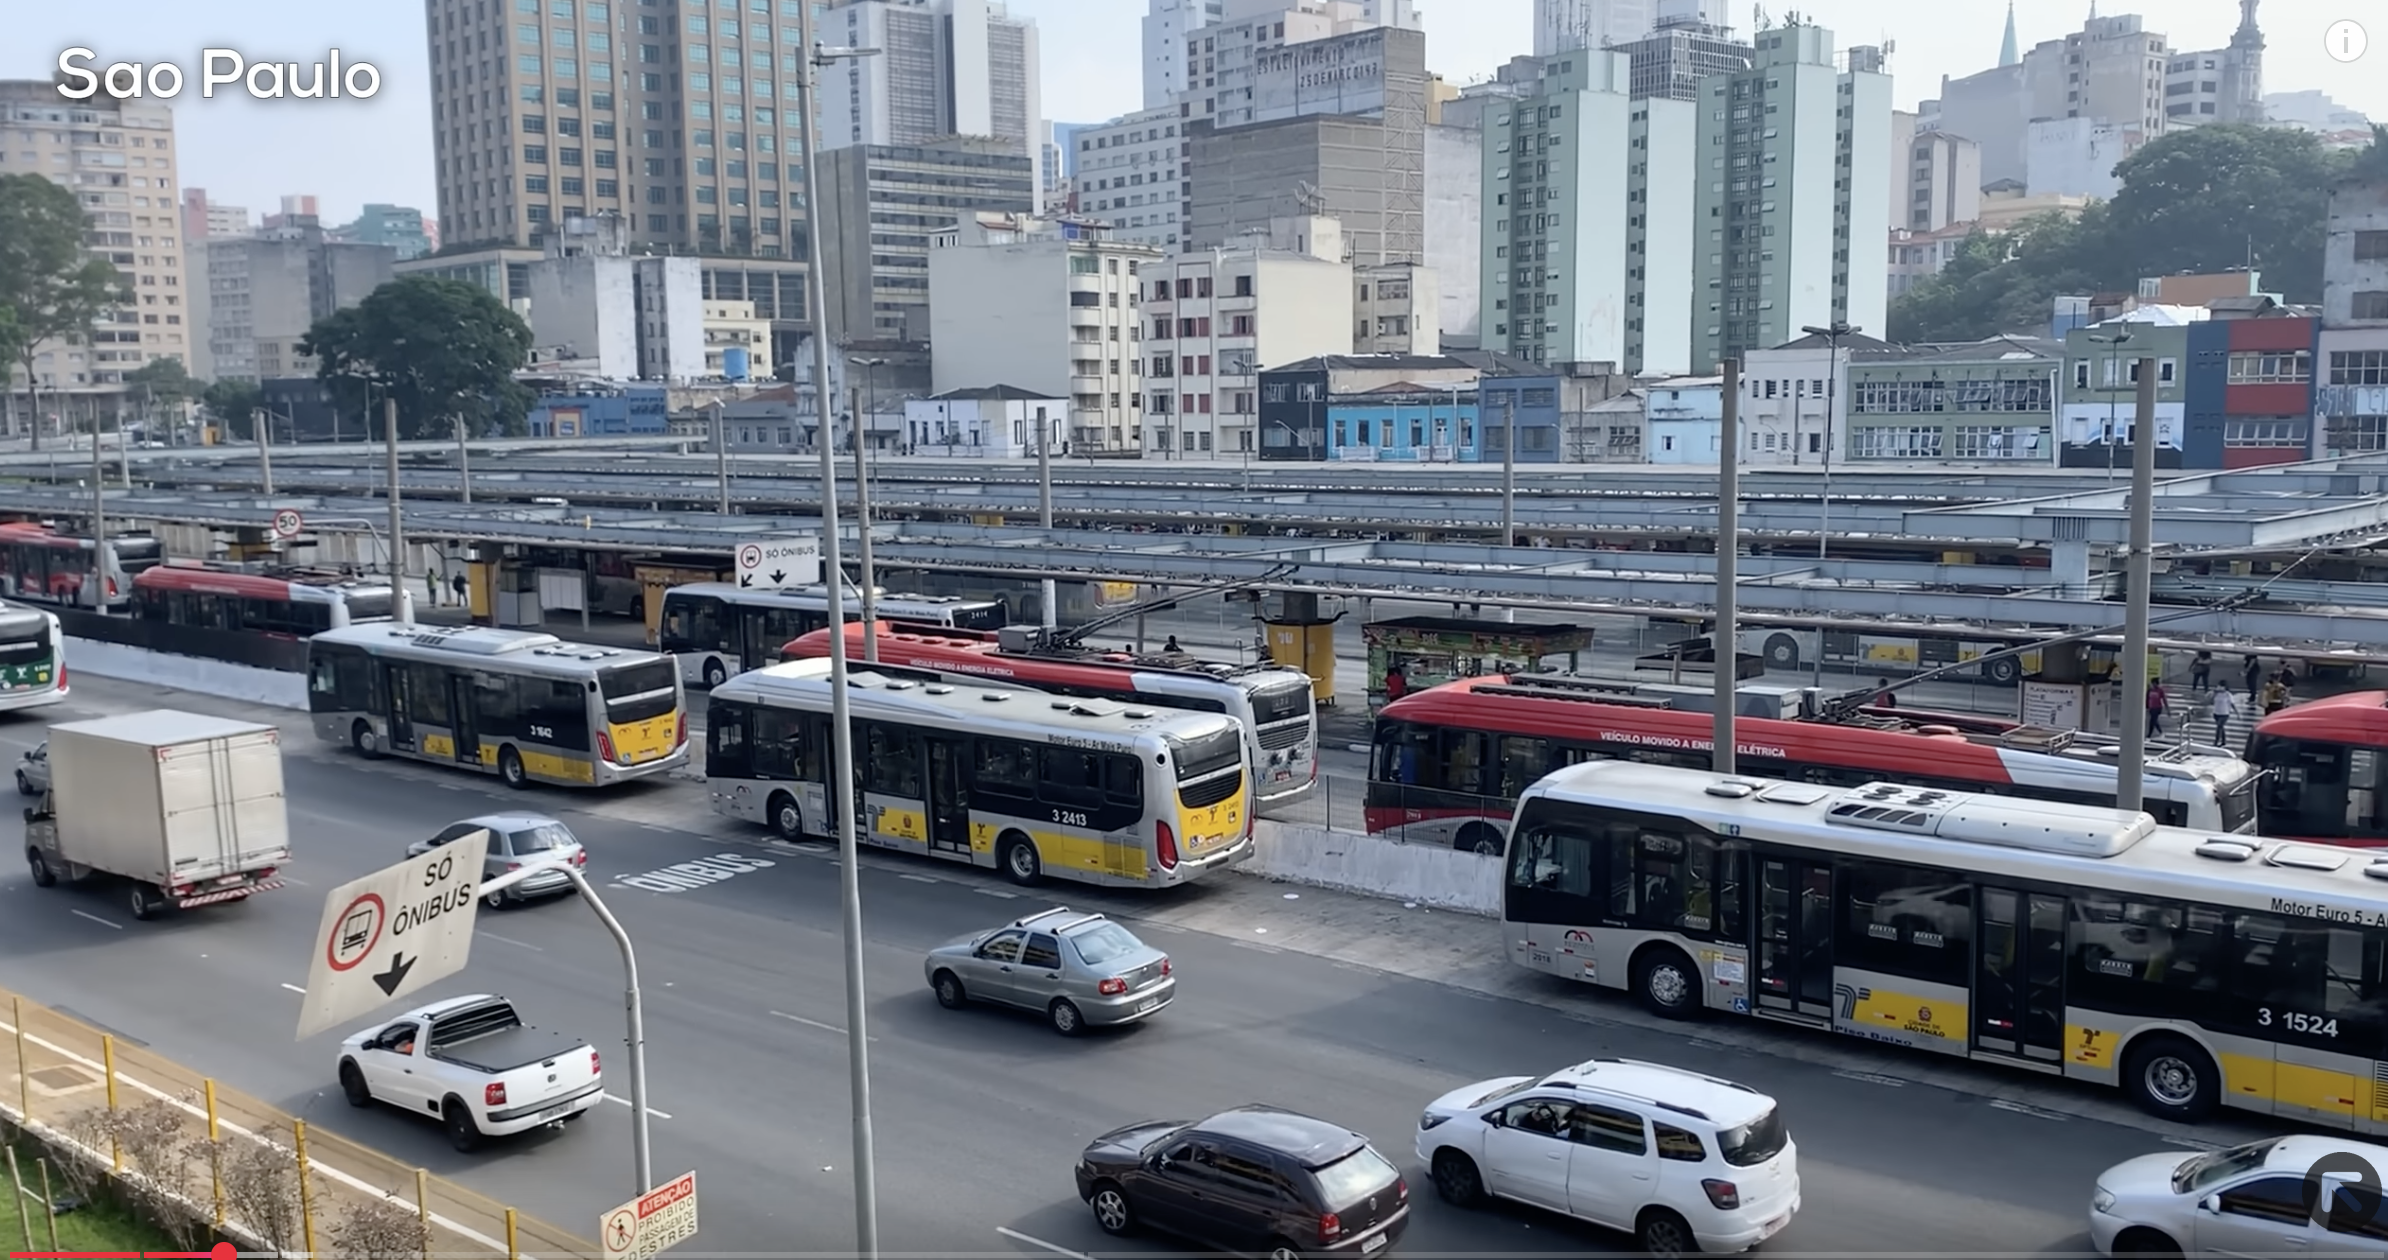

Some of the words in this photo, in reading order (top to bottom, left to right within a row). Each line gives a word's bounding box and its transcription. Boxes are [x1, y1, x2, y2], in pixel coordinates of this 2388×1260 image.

[279, 515, 297, 528] 50
[766, 547, 779, 559] SÓ
[781, 545, 815, 557] ÔNIBUS
[1600, 731, 1640, 744] VEÍCULO
[1642, 736, 1680, 748] MOVIDO
[1682, 739, 1690, 748] A
[1737, 744, 1786, 758] ELÉTRICA
[1052, 809, 1060, 822] 3
[1062, 811, 1087, 826] 2413
[424, 850, 453, 888] SÓ
[607, 853, 776, 893] ÔNIBUS
[393, 883, 471, 936] ÔNIBUS
[2271, 898, 2312, 916] Motor
[2316, 904, 2350, 923] Euro
[2355, 910, 2363, 925] 5
[2376, 913, 2388, 927] A
[1835, 1025, 1865, 1037] Piso
[1870, 1032, 1912, 1046] Baixo
[1920, 1027, 1945, 1037] PAULO
[2258, 1007, 2272, 1026] 3
[2282, 1012, 2339, 1038] 1524
[641, 1180, 691, 1215] ATENÇÃO
[638, 1196, 694, 1232] PROIBIDO
[639, 1217, 682, 1243] PASSAGEM
[683, 1208, 694, 1222] DE
[618, 1221, 695, 1260] DESTRES
